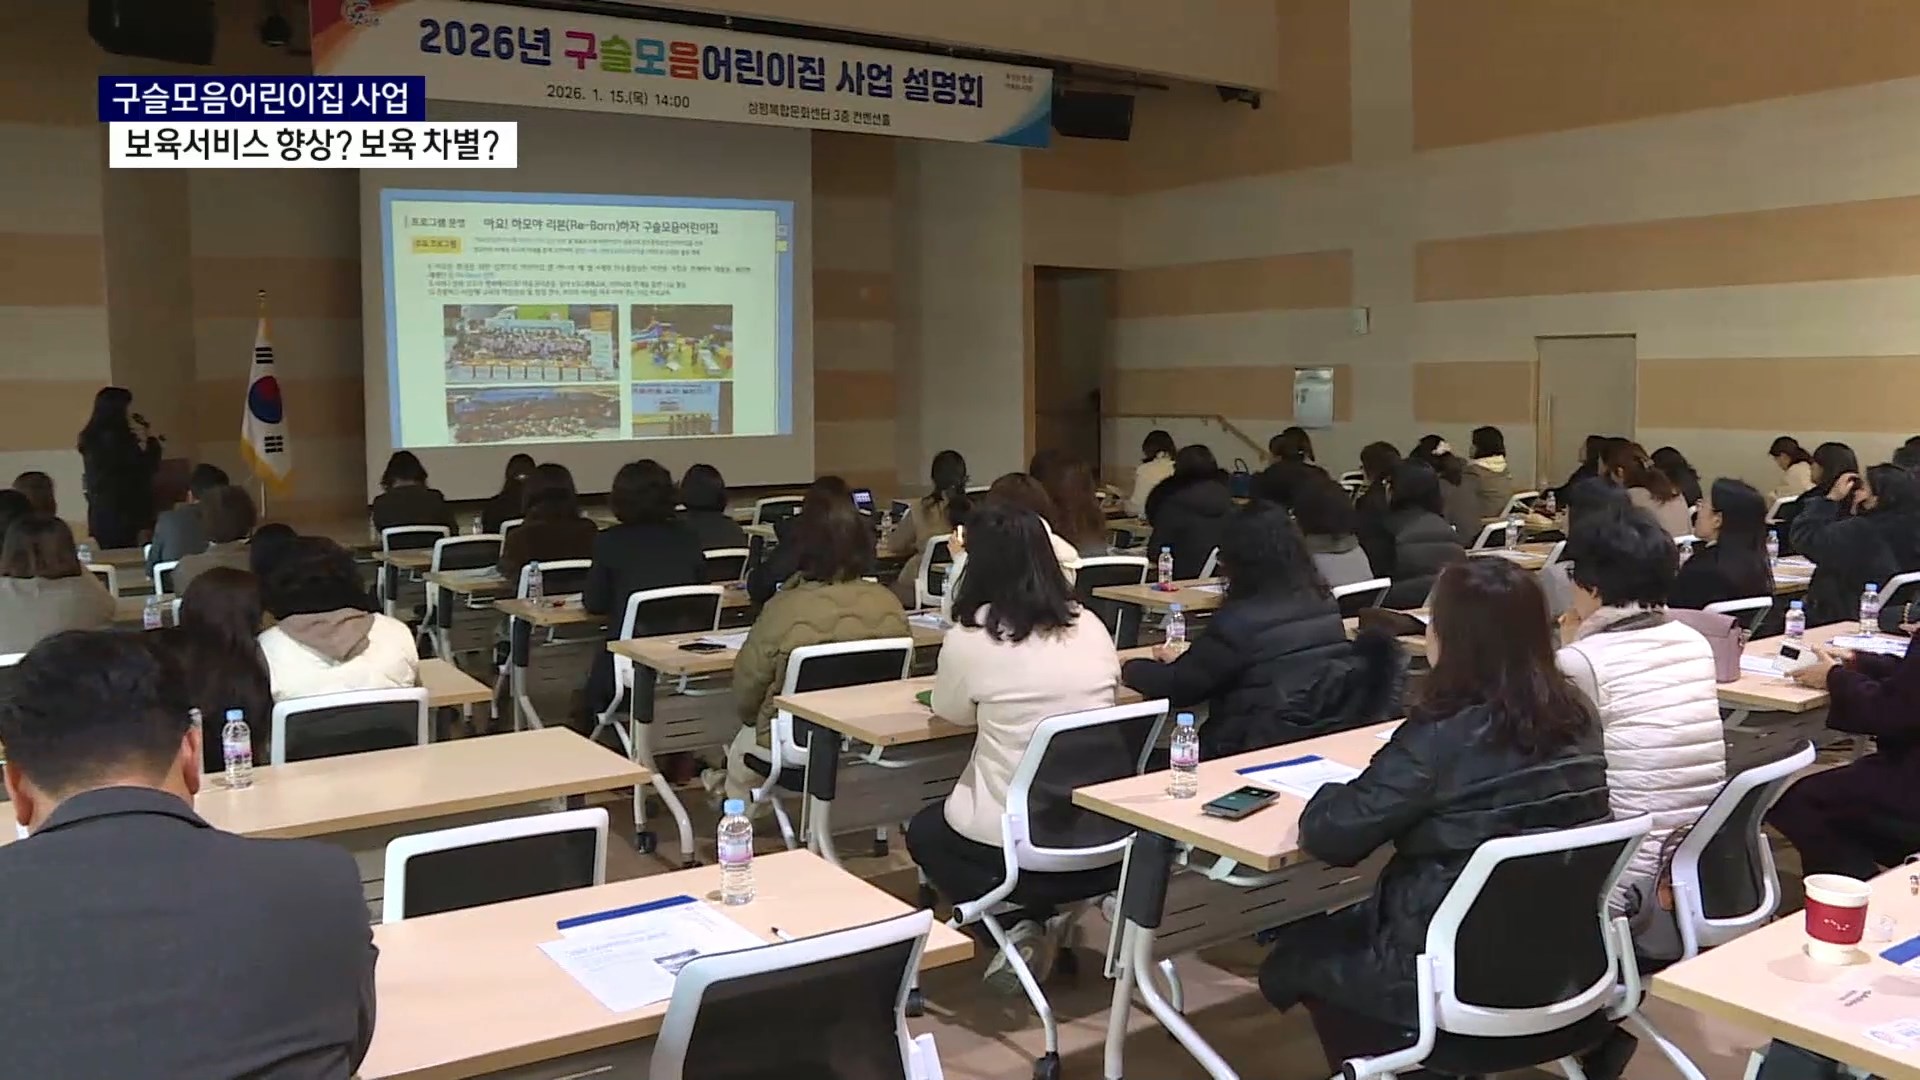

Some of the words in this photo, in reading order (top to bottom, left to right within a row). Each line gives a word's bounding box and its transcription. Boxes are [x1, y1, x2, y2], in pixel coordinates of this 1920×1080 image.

[420, 18, 551, 66] 2026년
[564, 30, 825, 92] 구슬모음어린이집
[836, 61, 893, 99] 사업
[903, 66, 984, 108] 설명회
[547, 84, 586, 100] 2026.
[593, 88, 603, 101] 1.
[655, 93, 690, 108] 14:00
[748, 102, 831, 121] 상평복합문화센터
[834, 109, 850, 123] 3층
[853, 111, 891, 126] 컨벤션홀
